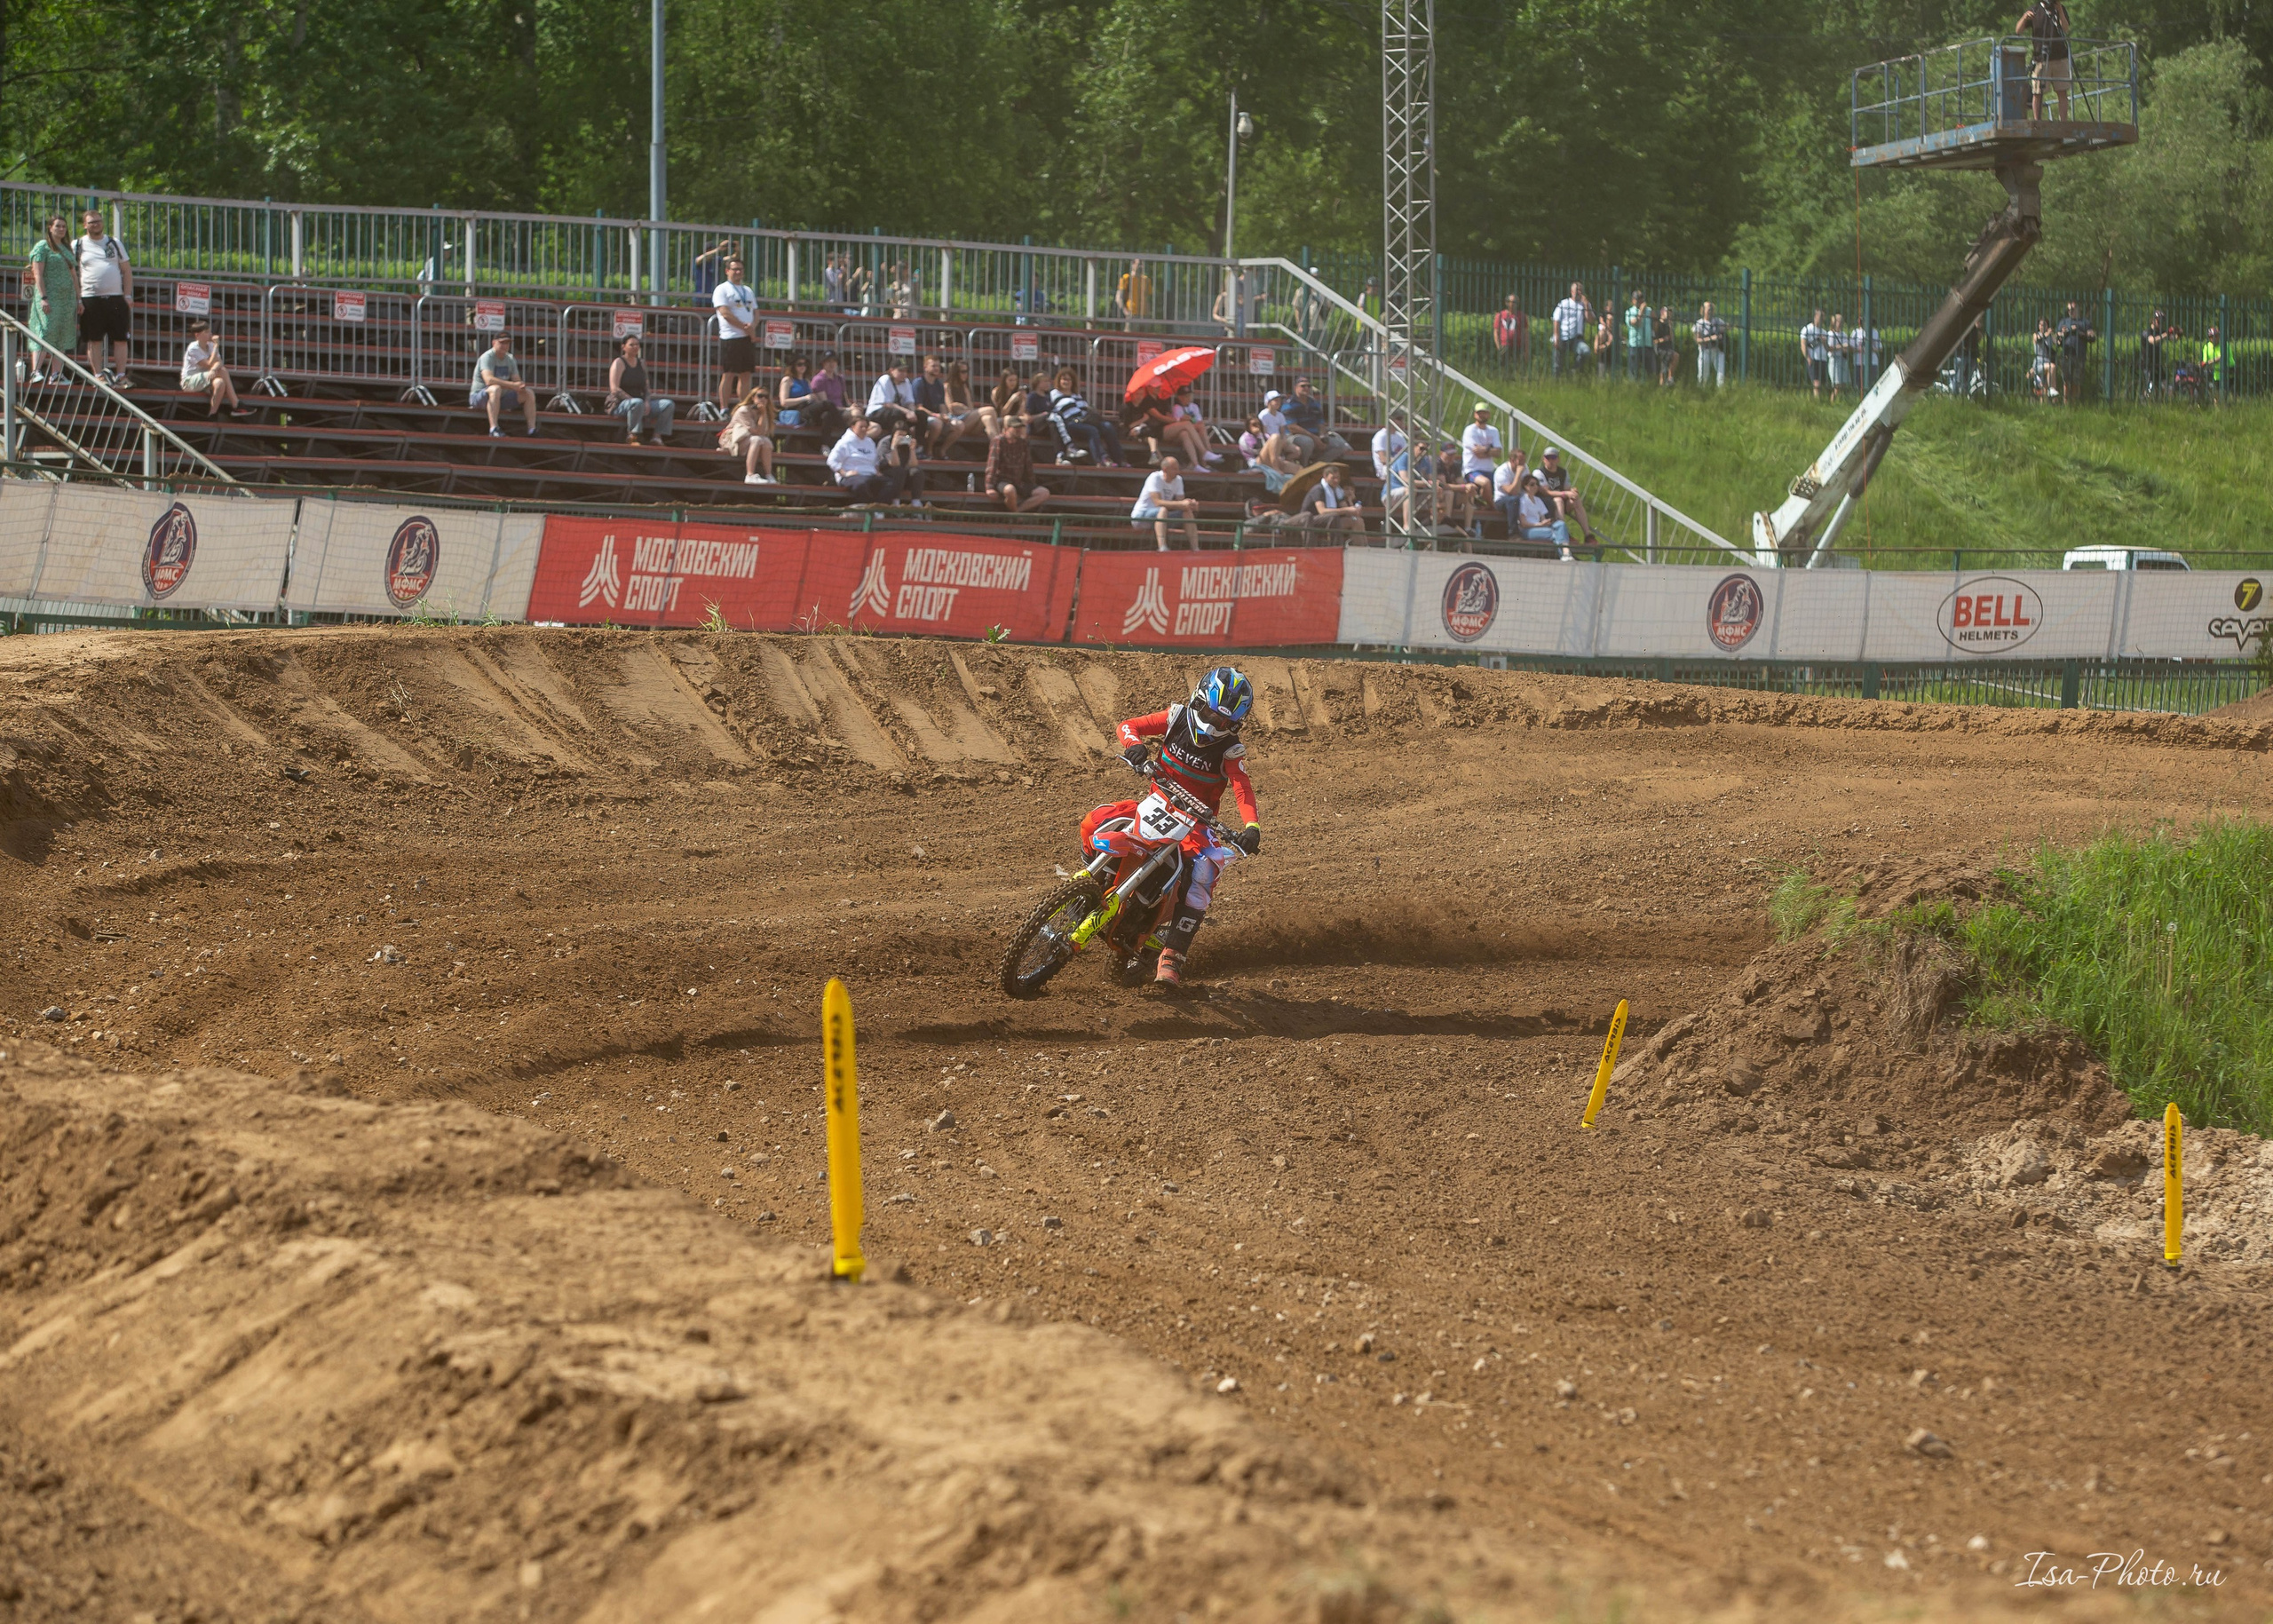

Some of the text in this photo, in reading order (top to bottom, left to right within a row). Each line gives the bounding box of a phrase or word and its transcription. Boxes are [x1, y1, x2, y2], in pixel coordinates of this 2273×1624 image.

[632, 535, 759, 579] МОСКОВСКИЙ
[902, 548, 1033, 592] МОСКОВСКИЙ
[623, 574, 685, 612] СПОРТ
[1180, 556, 1296, 600] МОСКОВСКИЙ
[895, 584, 959, 622] СПОРТ
[1953, 594, 2031, 628] BELL
[2239, 582, 2260, 610] 7
[1174, 602, 1234, 635] СПОРТ
[1959, 630, 2019, 642] HELMETS
[1168, 742, 1212, 772] SEVEN
[1168, 782, 1206, 814] RENTHAL
[1142, 806, 1180, 836] 33
[1604, 1017, 1621, 1064] ACERBIS
